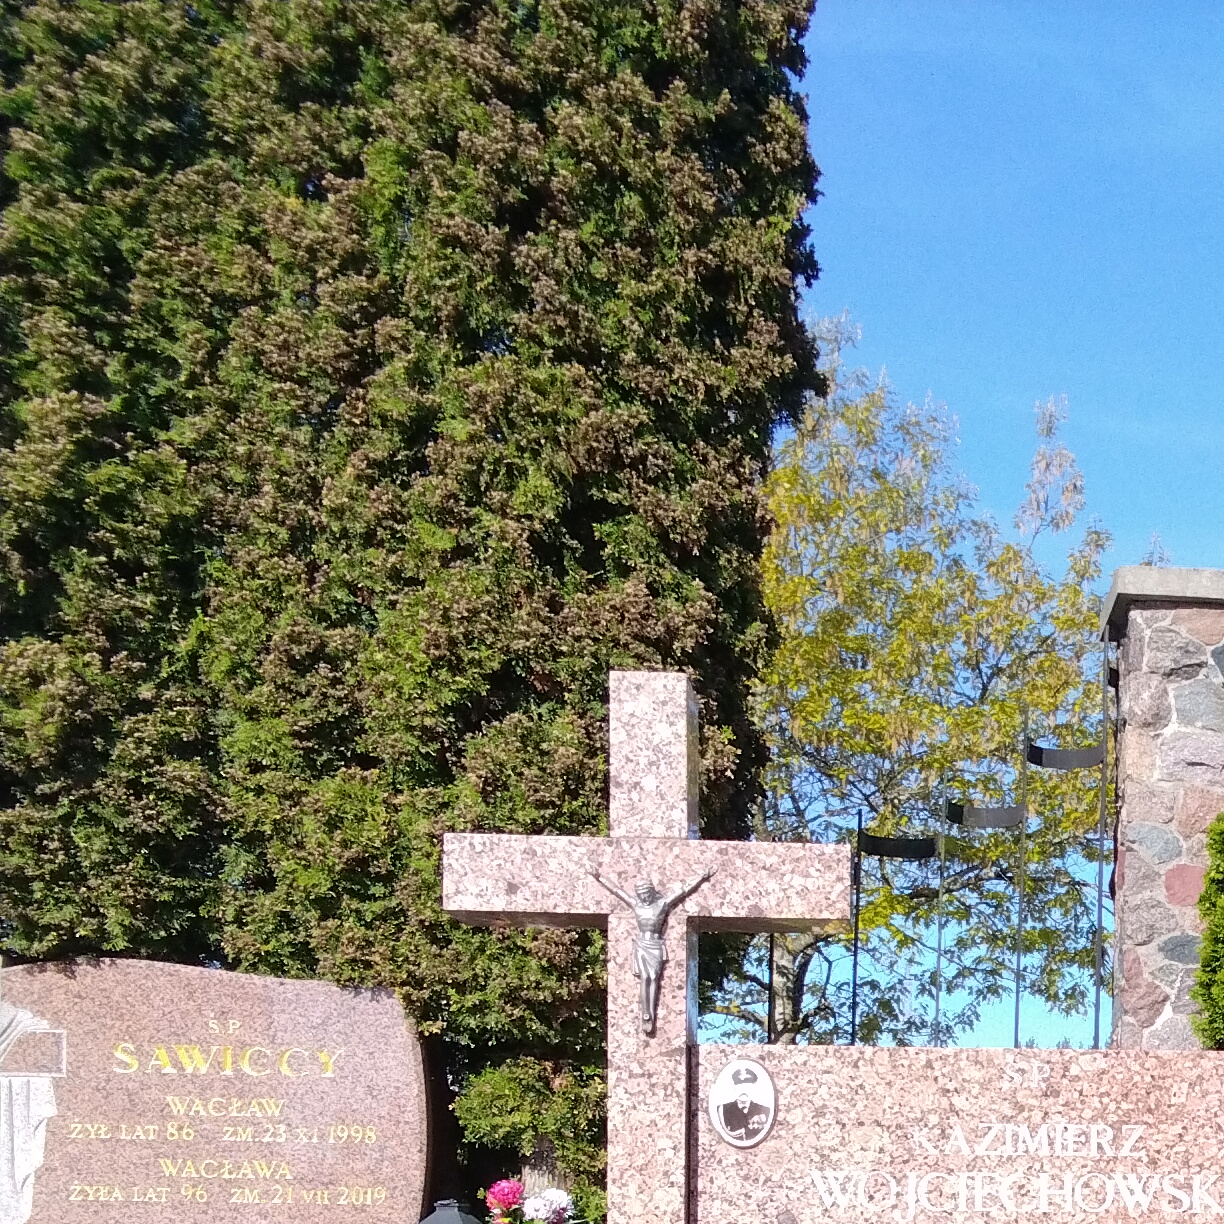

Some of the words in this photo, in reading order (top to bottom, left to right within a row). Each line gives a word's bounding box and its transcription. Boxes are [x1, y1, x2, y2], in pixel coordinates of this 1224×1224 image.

[113, 1042, 346, 1077] SAWICCY
[165, 1095, 286, 1117] WACŁAW
[69, 1118, 111, 1139] ŻYŁ
[119, 1124, 158, 1140] LAT
[166, 1121, 194, 1141] 86
[327, 1125, 378, 1144] 1998
[913, 1122, 1147, 1158] KAZIMIERZ
[158, 1158, 293, 1180] WACŁAWA
[69, 1179, 123, 1201] ŻYŁA
[132, 1186, 171, 1202] LAT
[180, 1184, 208, 1203] 96
[336, 1186, 386, 1206] 2019
